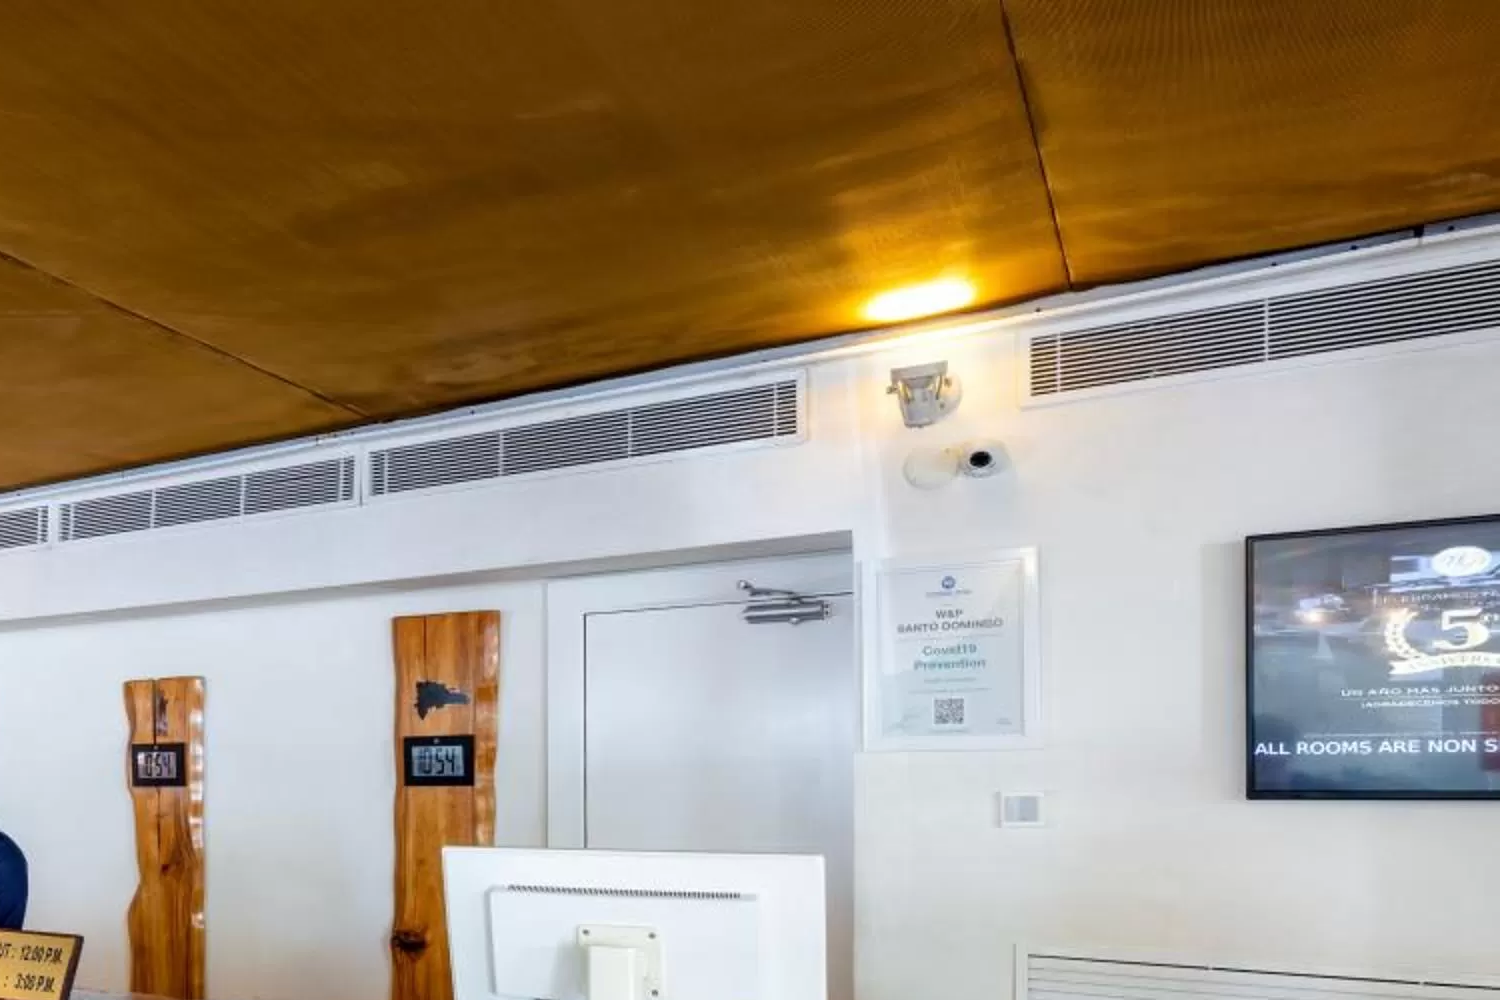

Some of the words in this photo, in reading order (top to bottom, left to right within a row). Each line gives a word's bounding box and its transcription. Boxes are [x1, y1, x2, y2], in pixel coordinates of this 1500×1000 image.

[897, 621, 939, 633] SANTO
[1254, 742, 1291, 756] ALL
[1296, 740, 1372, 756] ROOMS
[1378, 739, 1421, 753] ARE
[1427, 738, 1477, 753] NON
